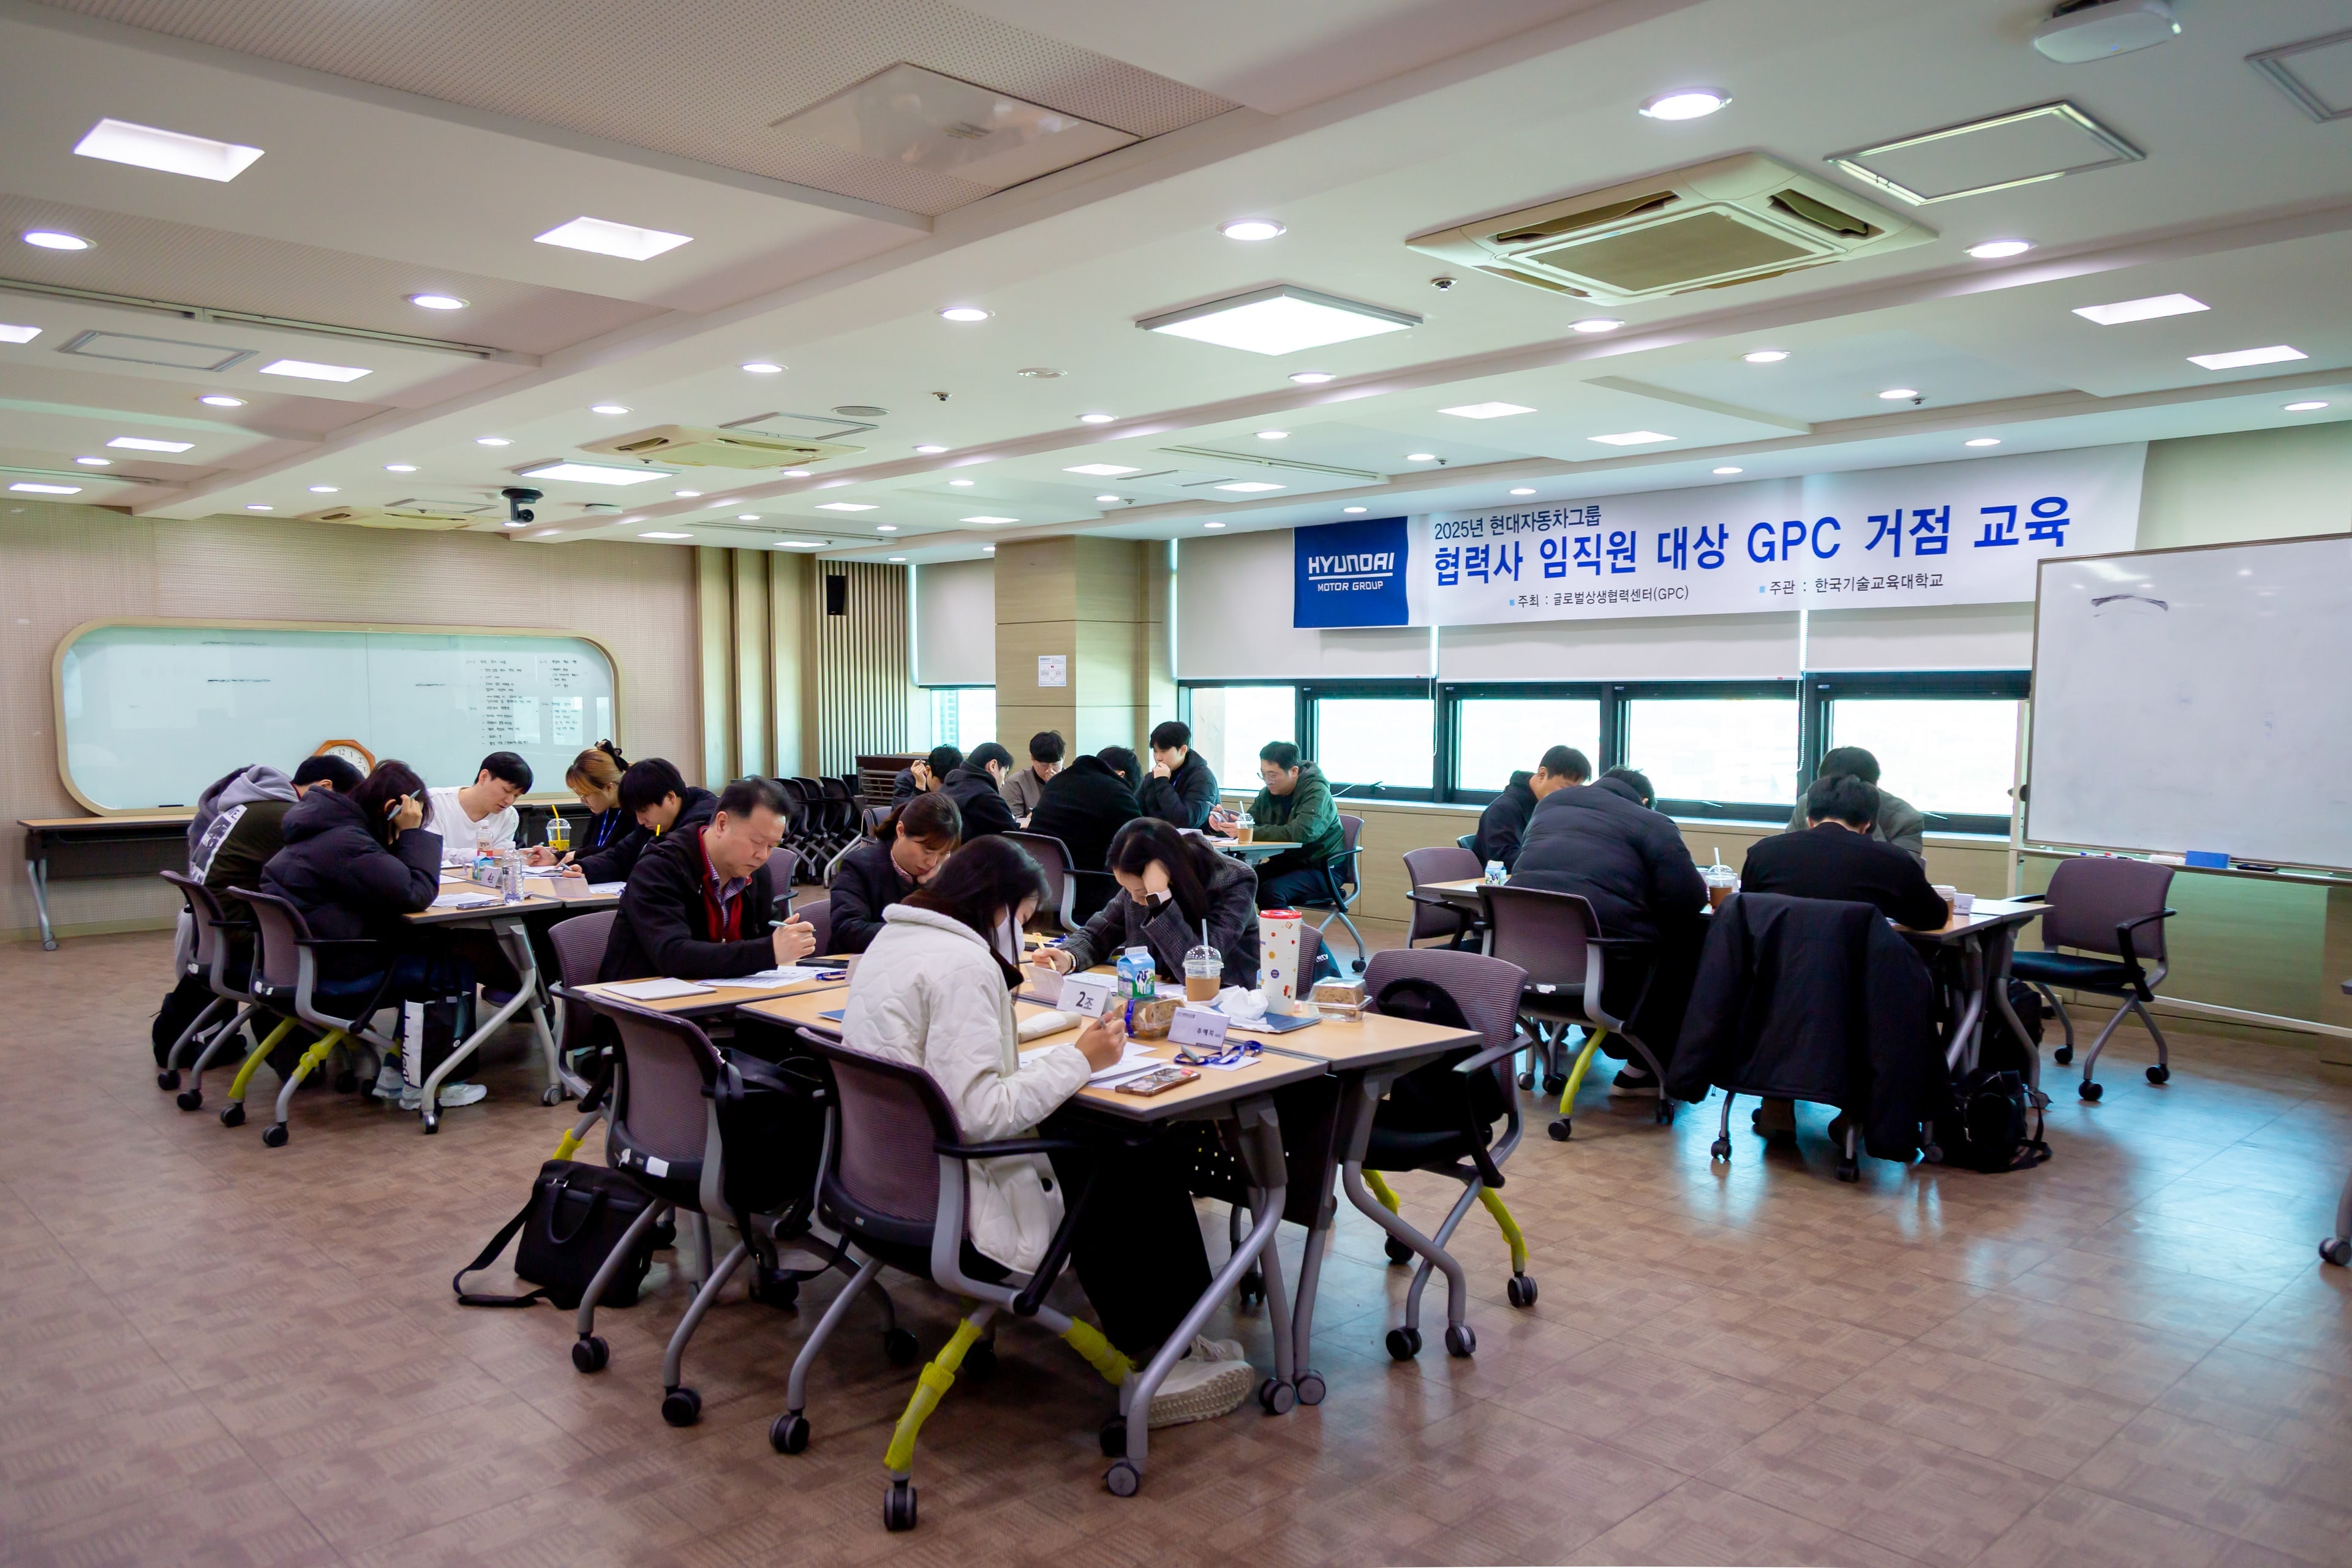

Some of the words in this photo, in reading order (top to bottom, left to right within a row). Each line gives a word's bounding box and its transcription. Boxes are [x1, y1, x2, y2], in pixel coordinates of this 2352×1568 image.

[1434, 517, 1483, 540] 2025년
[1490, 505, 1602, 536] 현대자동차그룹
[1435, 540, 1523, 587] 협력사
[1539, 530, 1637, 579] 임직원
[1657, 523, 1729, 571] 대상
[1747, 516, 1842, 564] GPC
[1865, 505, 1951, 558] 거점
[1973, 496, 2070, 548] 교육
[1308, 552, 1395, 574] HYUNDAI
[1317, 582, 1349, 592] MOTOR
[1352, 581, 1384, 590] GROUP
[1770, 580, 1795, 595] 주관
[1815, 573, 1943, 593] 한국기술교육대학교
[1518, 594, 1540, 608] 주최
[1553, 585, 1689, 606] 글로벌상생협력센터(GPC)
[1076, 991, 1094, 1010] 2조
